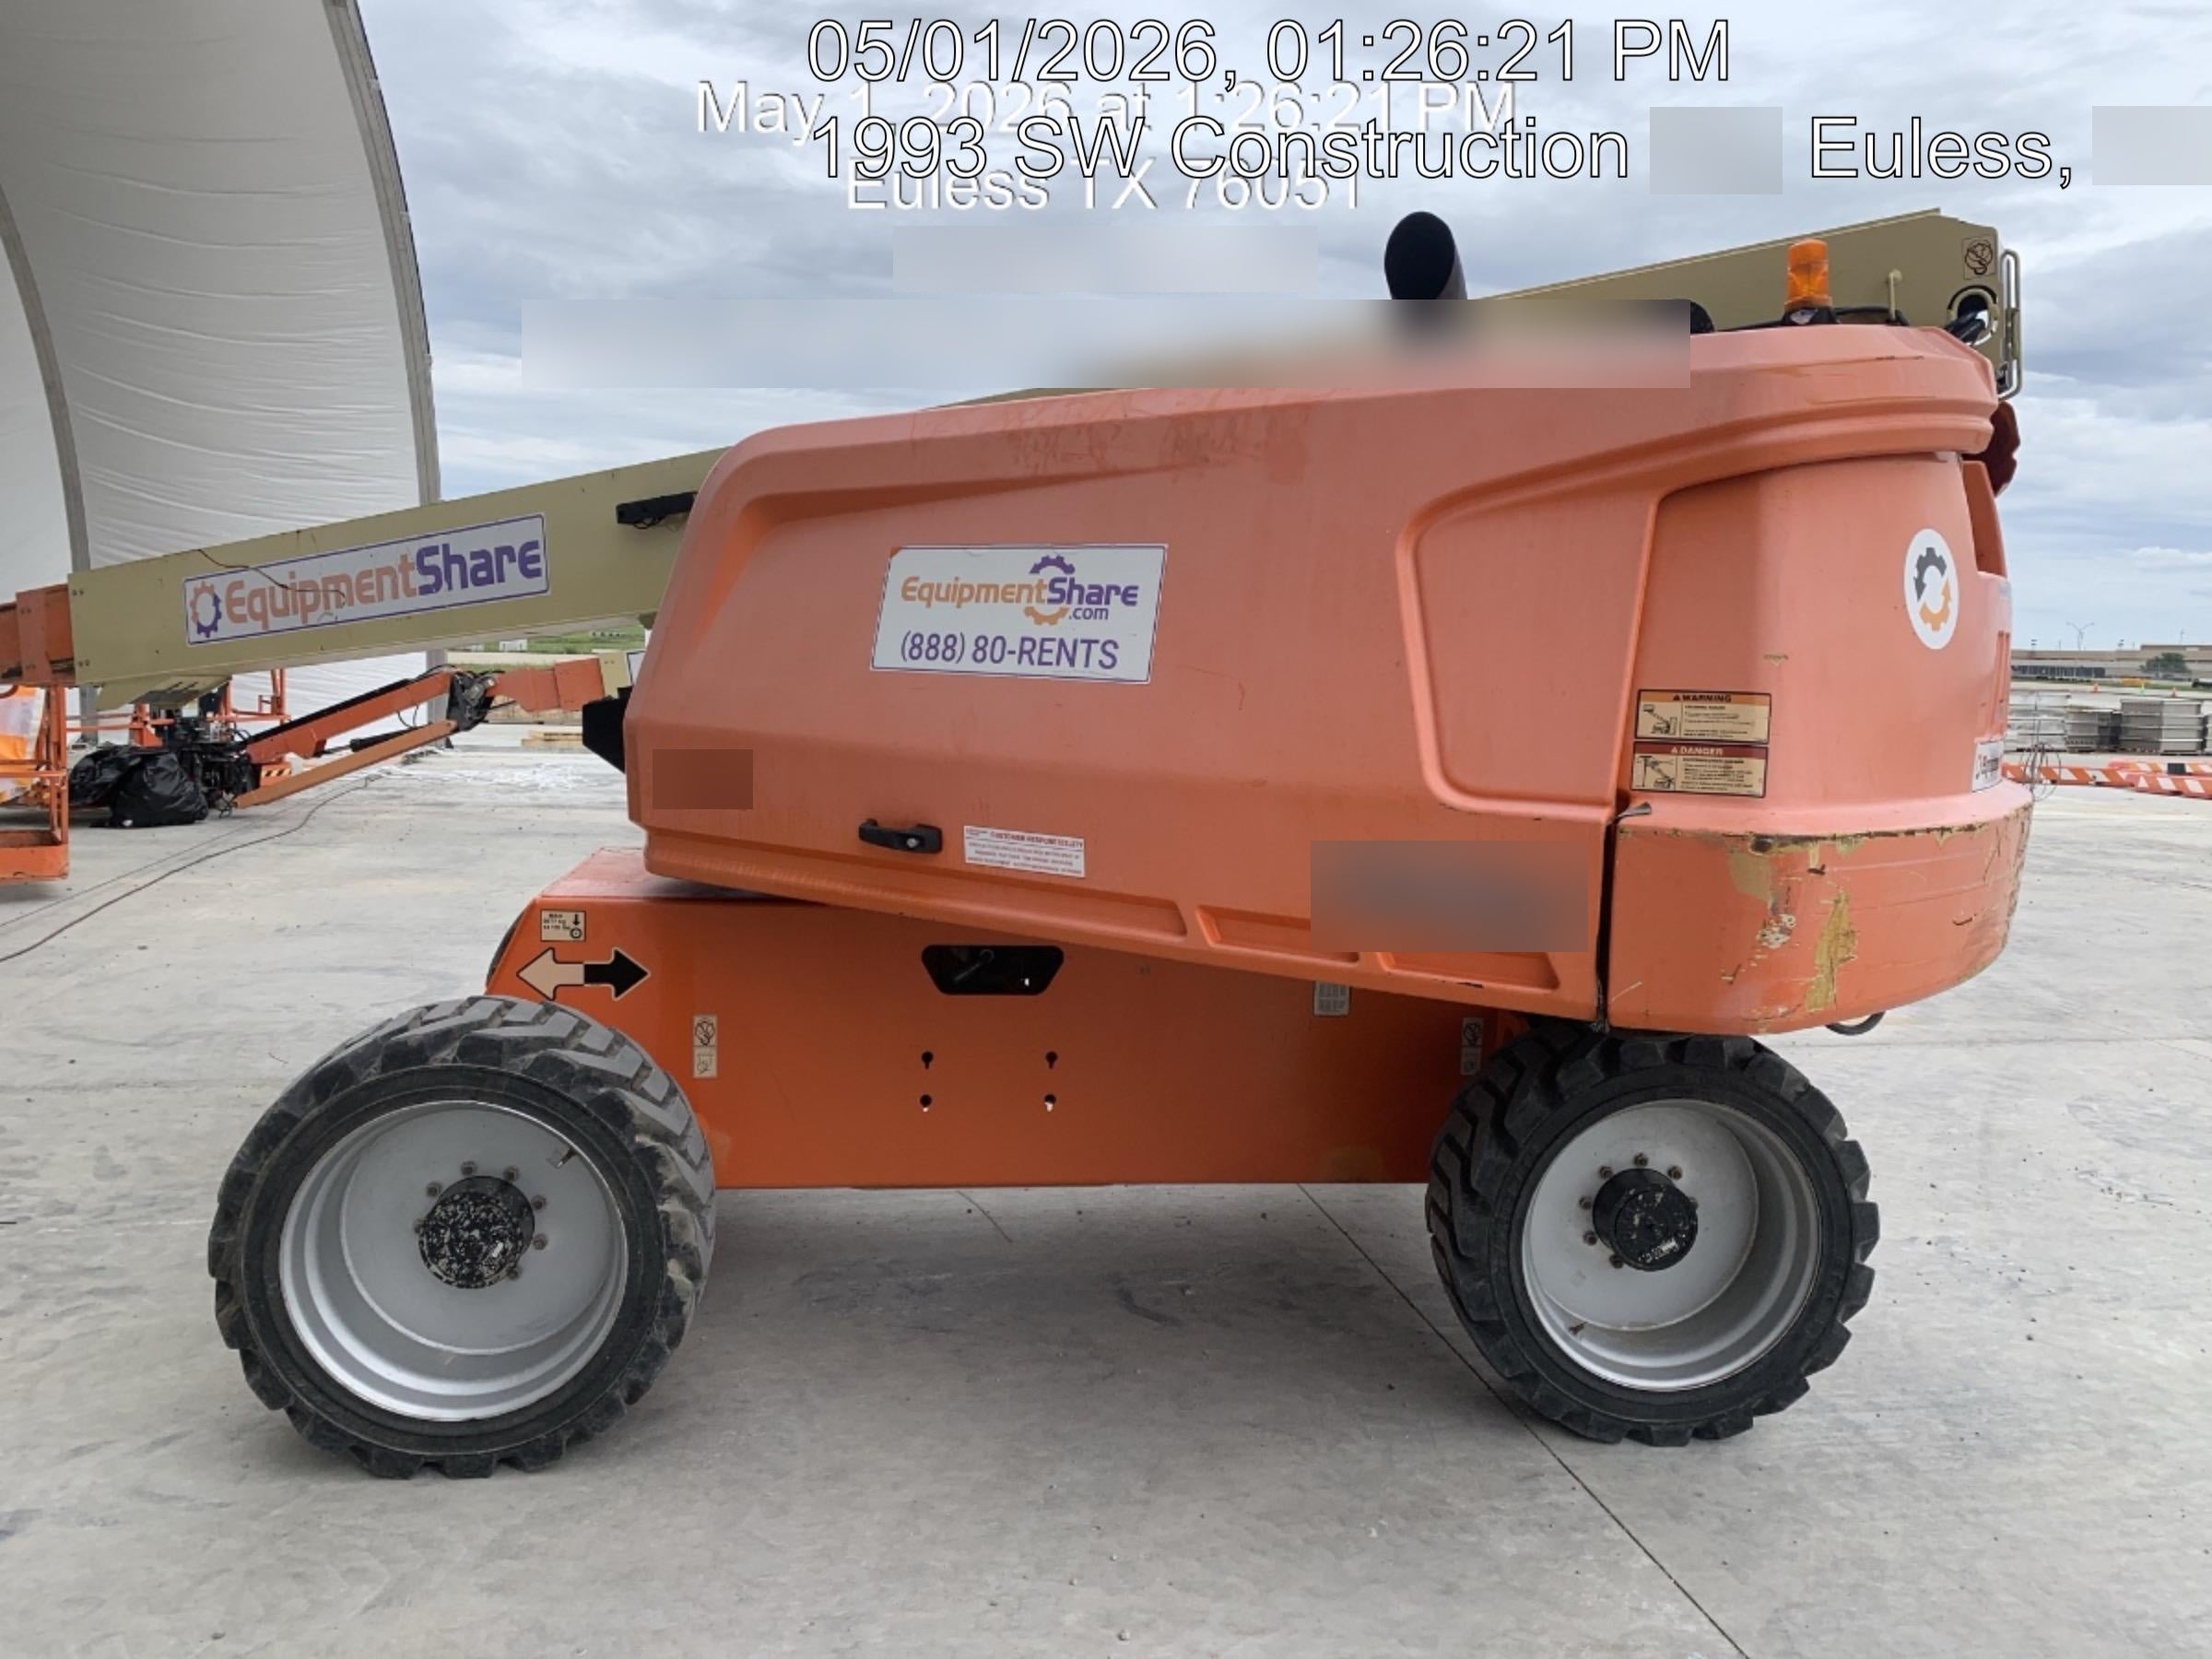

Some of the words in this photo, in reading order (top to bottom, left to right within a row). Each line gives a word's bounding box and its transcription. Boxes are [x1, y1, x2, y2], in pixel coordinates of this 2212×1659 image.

[225, 539, 543, 630] EquipmentShare
[900, 576, 1139, 608] EquipmentShare
[1068, 607, 1109, 620] .com
[900, 629, 966, 665] (888)
[972, 634, 1120, 670] 80-RENTS
[1682, 694, 1732, 703] WARNING
[1680, 747, 1724, 756] DANGER
